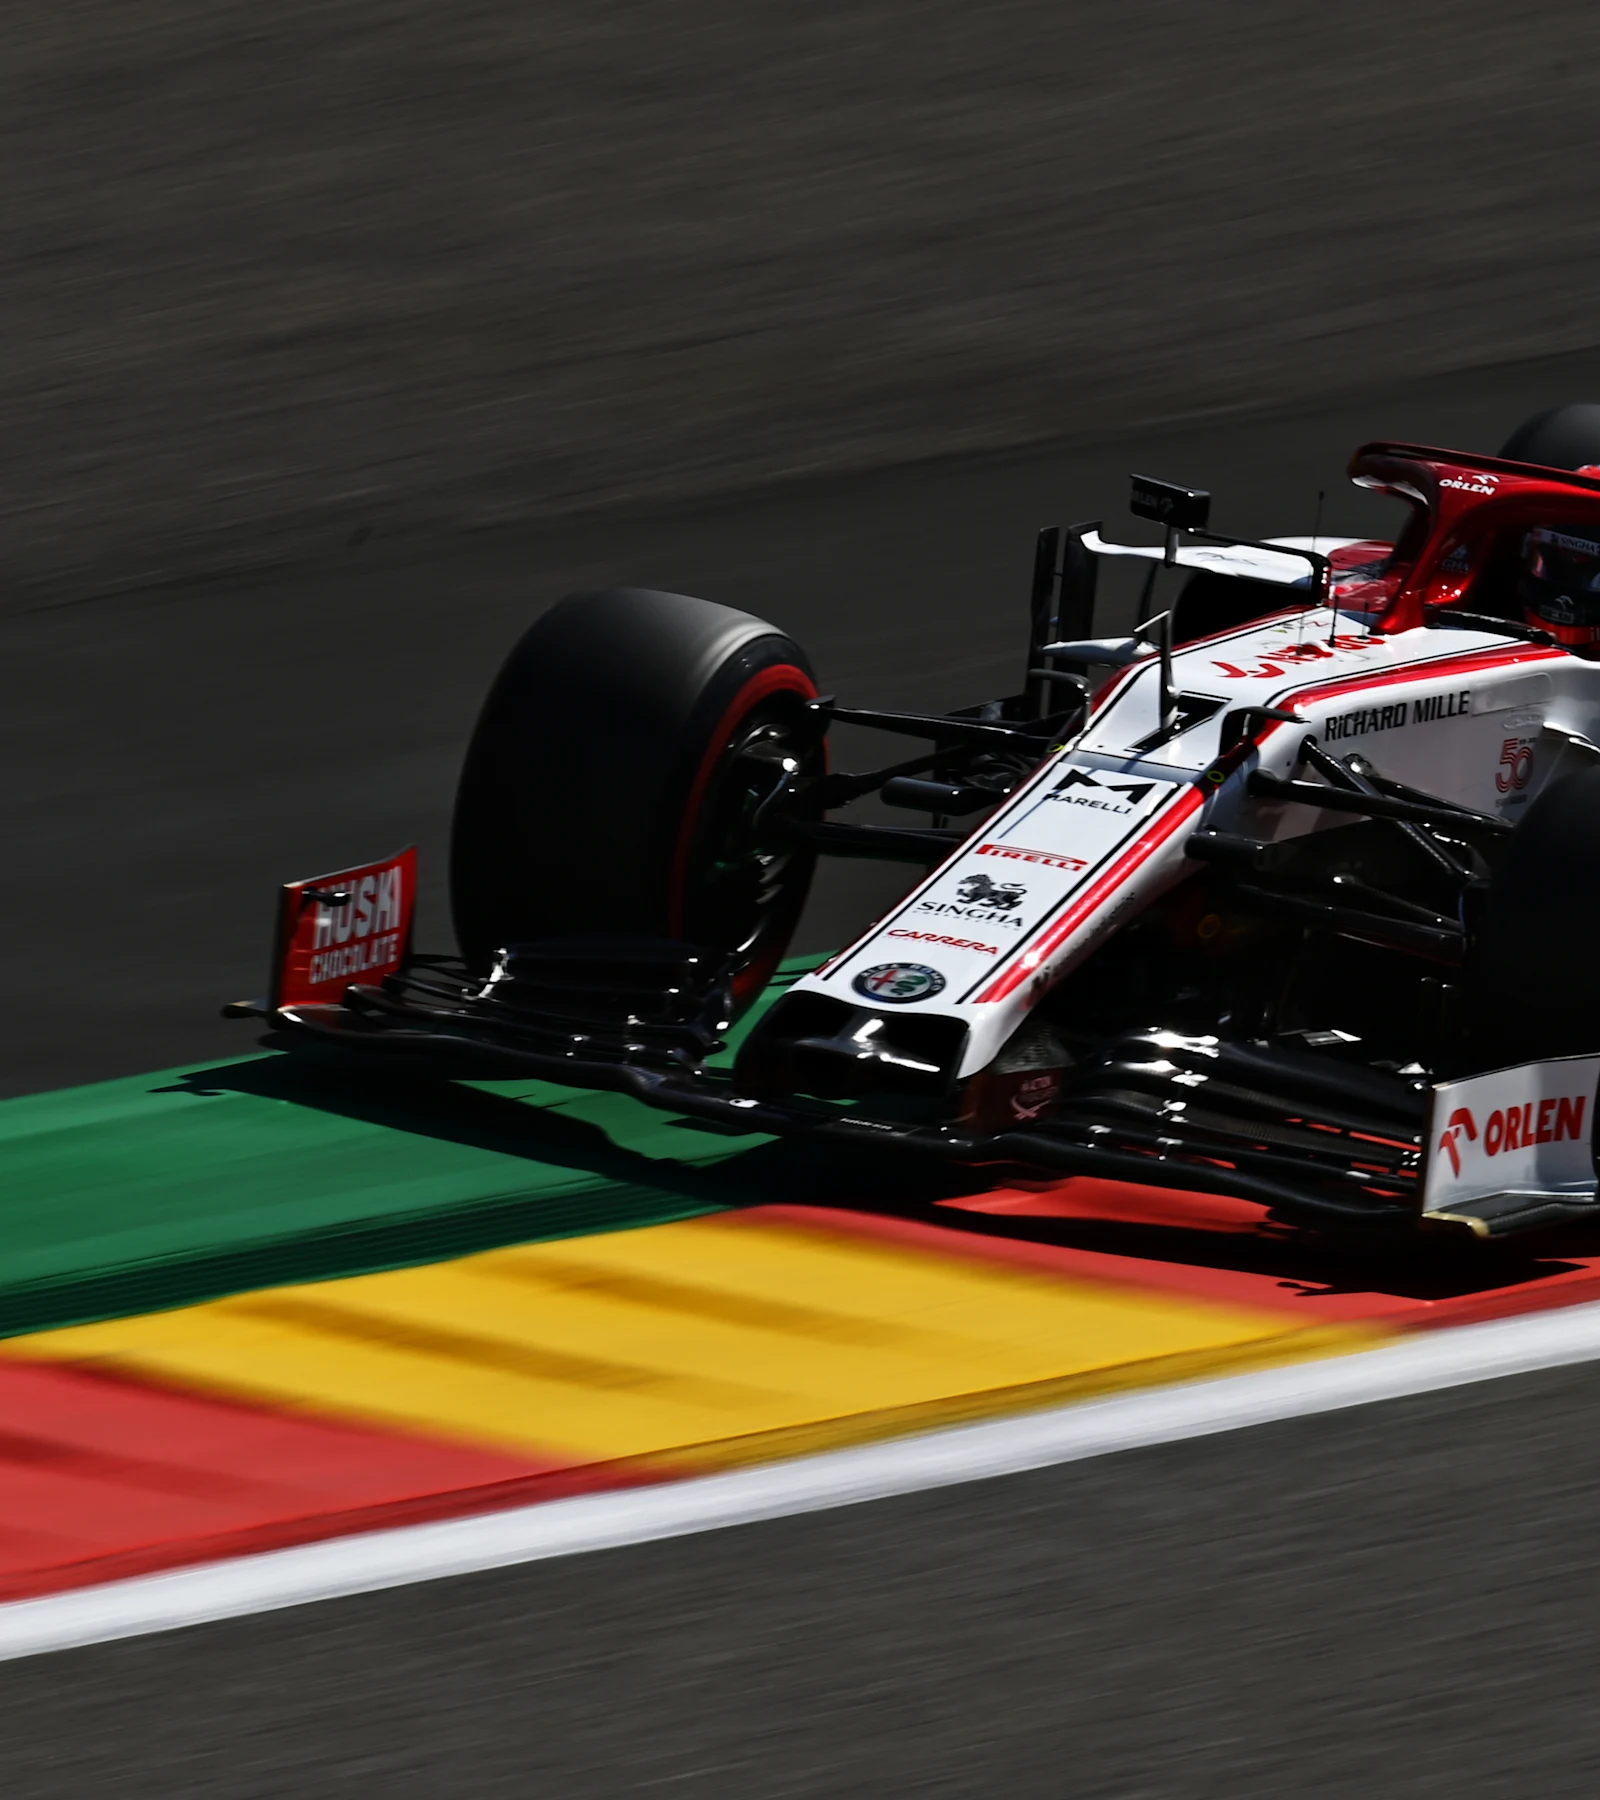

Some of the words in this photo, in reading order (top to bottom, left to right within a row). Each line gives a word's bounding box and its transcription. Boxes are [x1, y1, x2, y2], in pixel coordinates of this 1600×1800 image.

[1438, 478, 1497, 496] ORLEN
[1324, 702, 1408, 742] RICHARD
[1412, 690, 1471, 725] MILLE
[1495, 738, 1534, 793] 50
[1043, 793, 1134, 815] MARELLI
[975, 844, 1089, 872] PIRELLI
[313, 866, 402, 950] HUSKI
[916, 901, 1023, 927] SINGHA
[310, 933, 400, 984] CHOCOLATE
[887, 929, 999, 955] CARRERA
[1485, 1096, 1587, 1157] ORLEN
